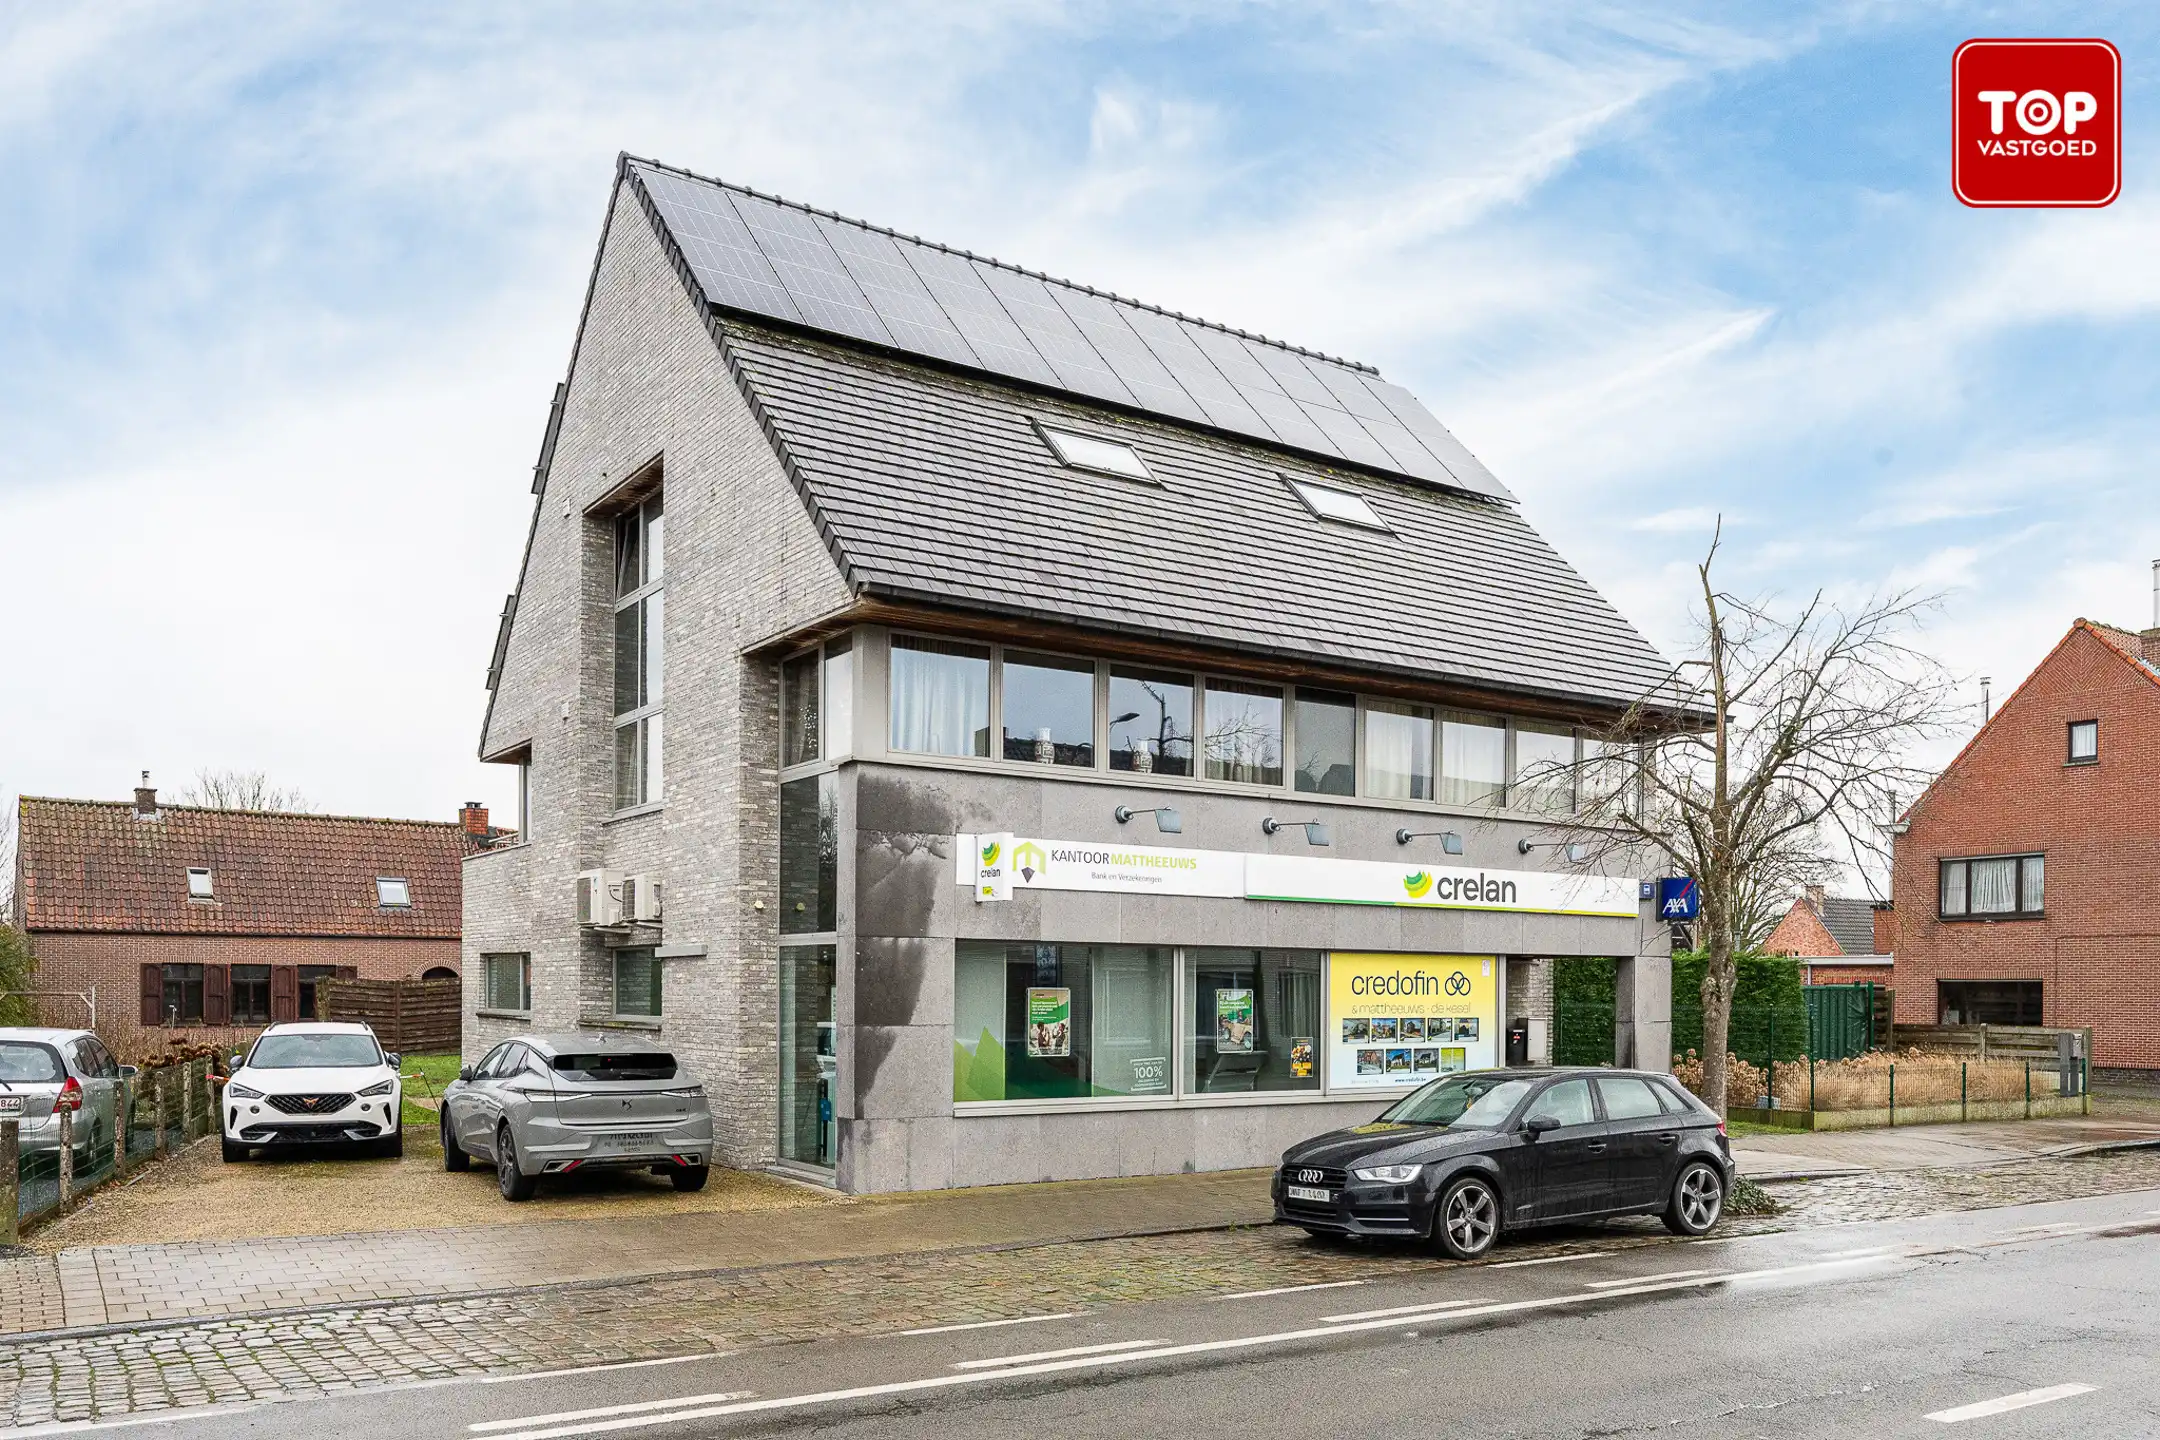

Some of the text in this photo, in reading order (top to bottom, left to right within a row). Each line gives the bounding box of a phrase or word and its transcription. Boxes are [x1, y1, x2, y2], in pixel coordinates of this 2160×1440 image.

[1051, 849, 1197, 870] KANTOOR MATTHEEUWS
[980, 868, 1001, 878] crelan
[1091, 871, 1107, 880] Bank
[1437, 872, 1517, 904] crelan
[1662, 898, 1689, 913] AXA
[1351, 970, 1439, 996] credofin
[1351, 1004, 1358, 1014] &
[1358, 1000, 1425, 1014] mattheeuws
[1430, 1001, 1444, 1014] de
[1133, 1065, 1163, 1079] 100%
